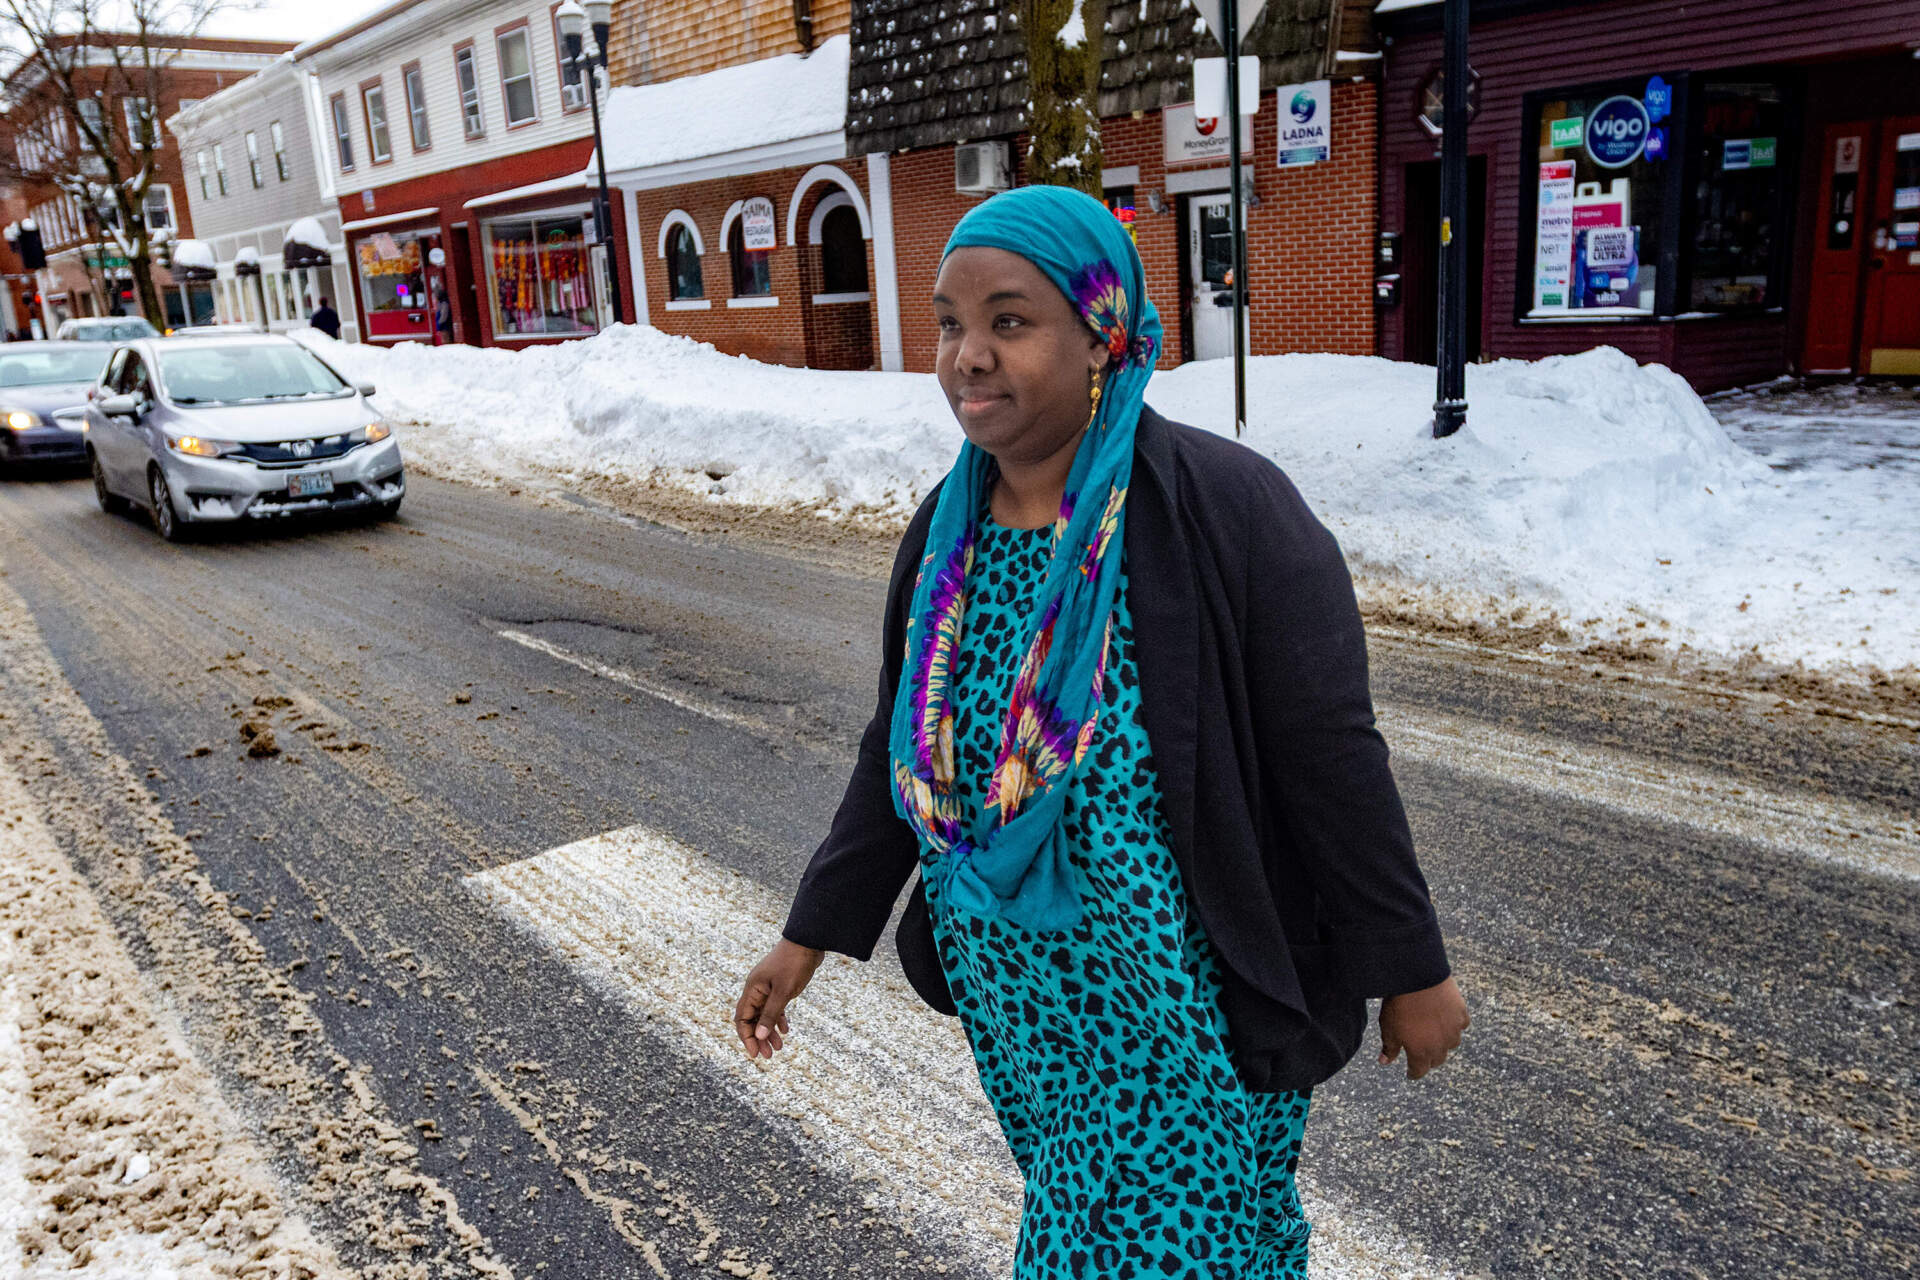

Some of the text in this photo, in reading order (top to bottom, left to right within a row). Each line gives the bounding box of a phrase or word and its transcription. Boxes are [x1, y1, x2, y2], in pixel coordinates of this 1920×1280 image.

[1594, 114, 1643, 140] vigo
[1283, 126, 1323, 140] LADNA
[1542, 216, 1571, 225] metro
[1594, 232, 1626, 240] ALWAYS
[1594, 244, 1626, 252] ALWAYS
[1593, 250, 1626, 260] ULTRA
